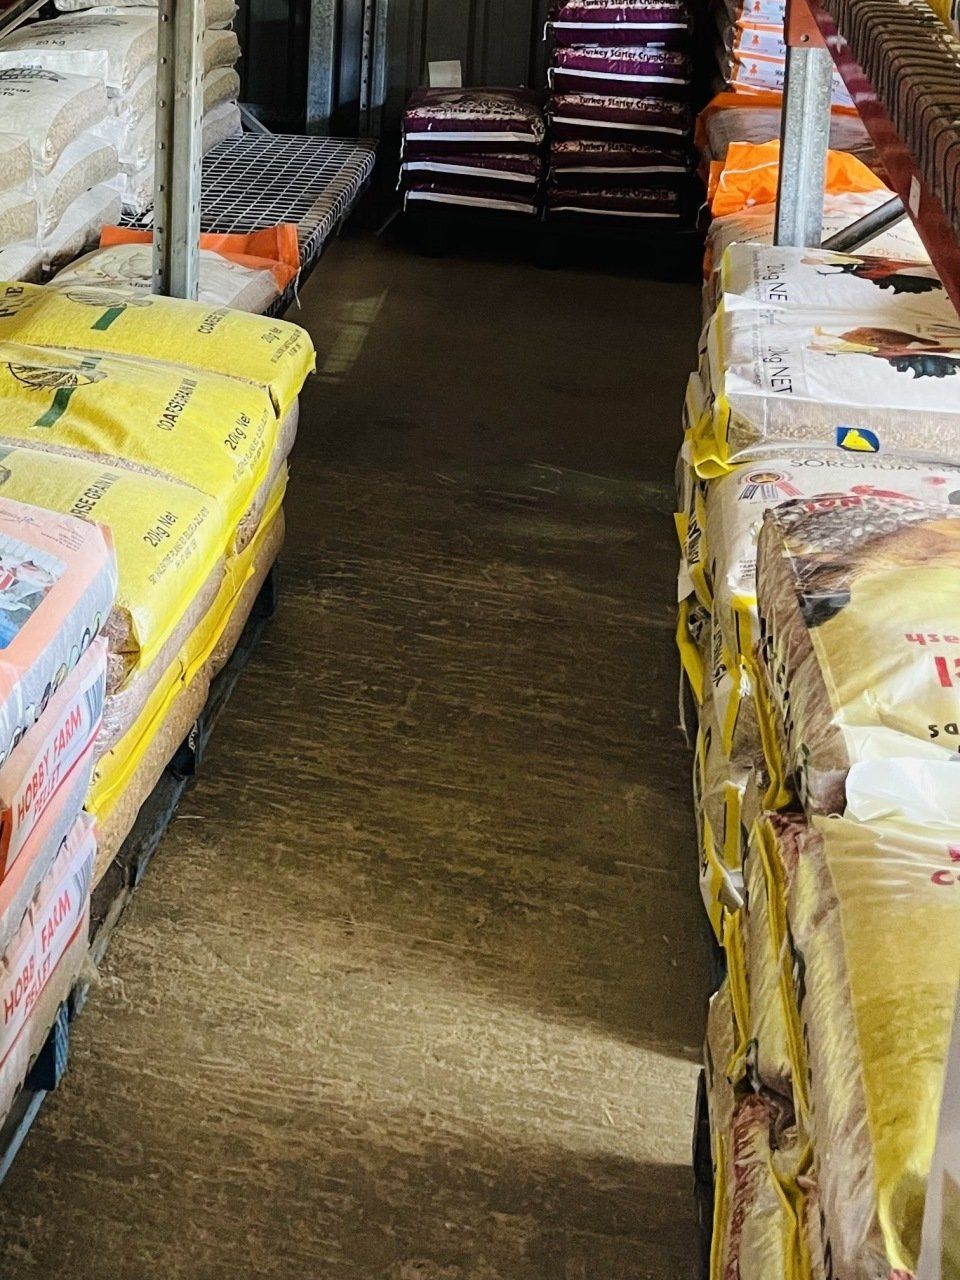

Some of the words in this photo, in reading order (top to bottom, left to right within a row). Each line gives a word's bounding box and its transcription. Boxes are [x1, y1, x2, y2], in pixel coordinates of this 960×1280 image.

[582, 48, 608, 59] Turkey
[610, 49, 637, 59] Starter
[579, 95, 606, 106] Turkey
[607, 97, 634, 108] Starter
[769, 366, 793, 394] NET
[157, 400, 178, 432] COARSE
[224, 426, 247, 451] 20kg
[790, 458, 917, 471] SORGHUM
[87, 480, 109, 506] GRAIN
[143, 526, 164, 548] 20kg
[159, 511, 178, 531] Net
[16, 756, 52, 826] HOBBY
[52, 704, 83, 753] FARM
[34, 762, 63, 815] PELLET
[40, 889, 73, 952] FARM
